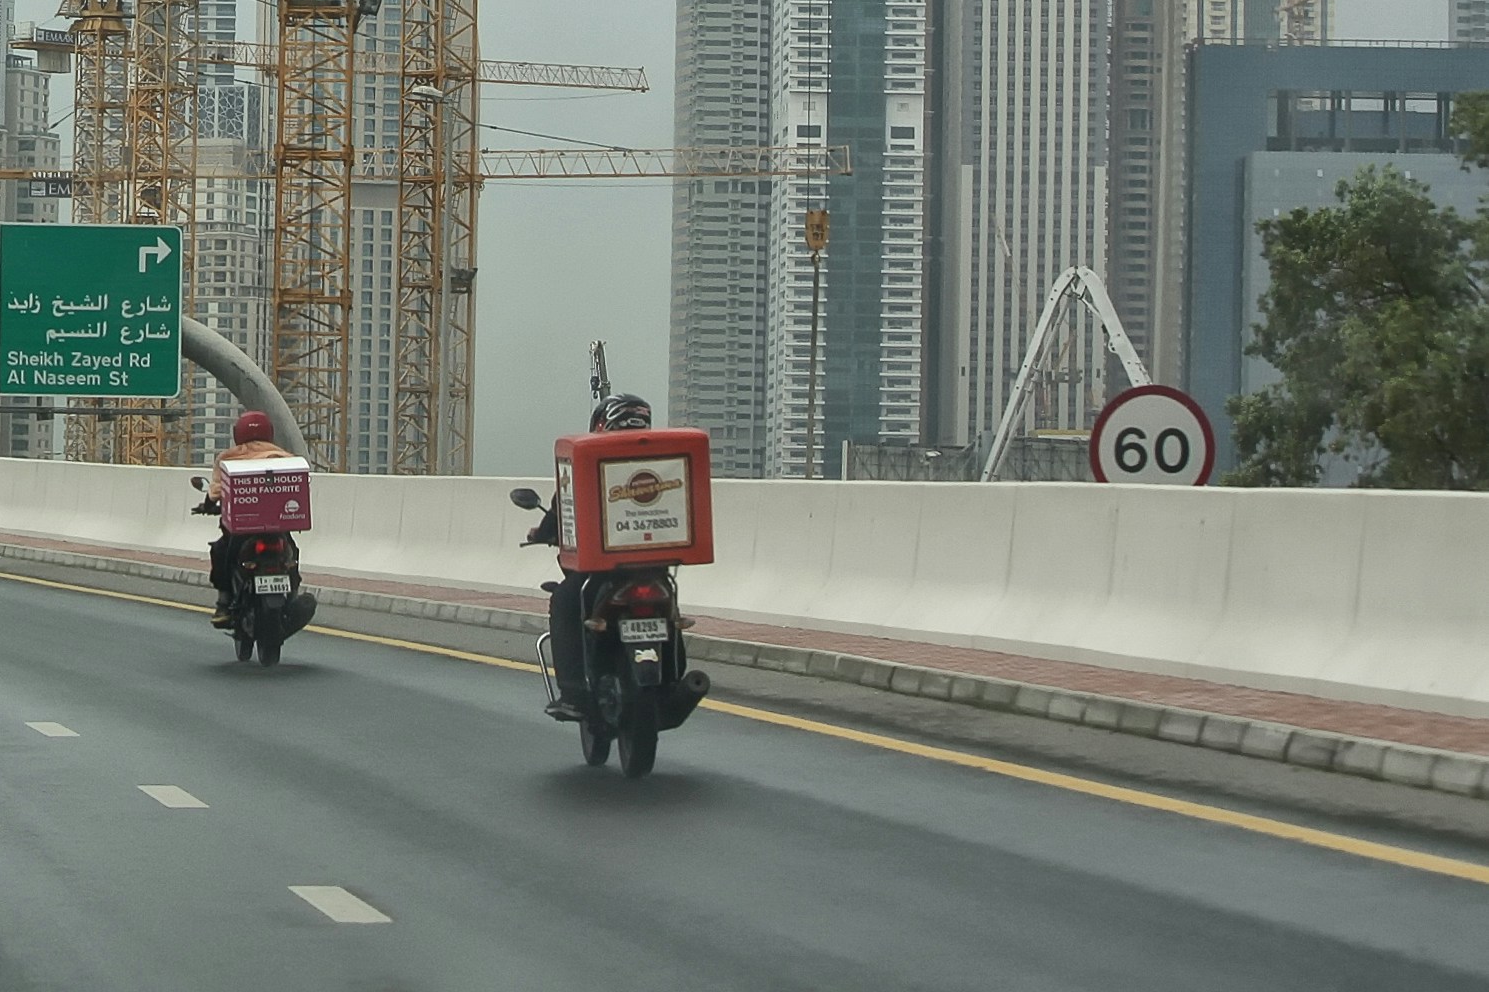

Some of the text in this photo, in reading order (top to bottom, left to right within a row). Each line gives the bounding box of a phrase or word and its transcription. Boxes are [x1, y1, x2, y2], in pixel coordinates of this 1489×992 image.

[7, 292, 171, 319] شارع الشيخ زايد
[45, 320, 171, 345] شارع النسيم
[7, 350, 151, 370] Sheikh Zayed Rd
[7, 369, 129, 387] Al Naseem St
[1114, 426, 1190, 474] 60
[253, 476, 271, 484] BO
[273, 475, 303, 483] HOLDS
[259, 485, 300, 493] FAVORITE
[616, 521, 630, 531] 04
